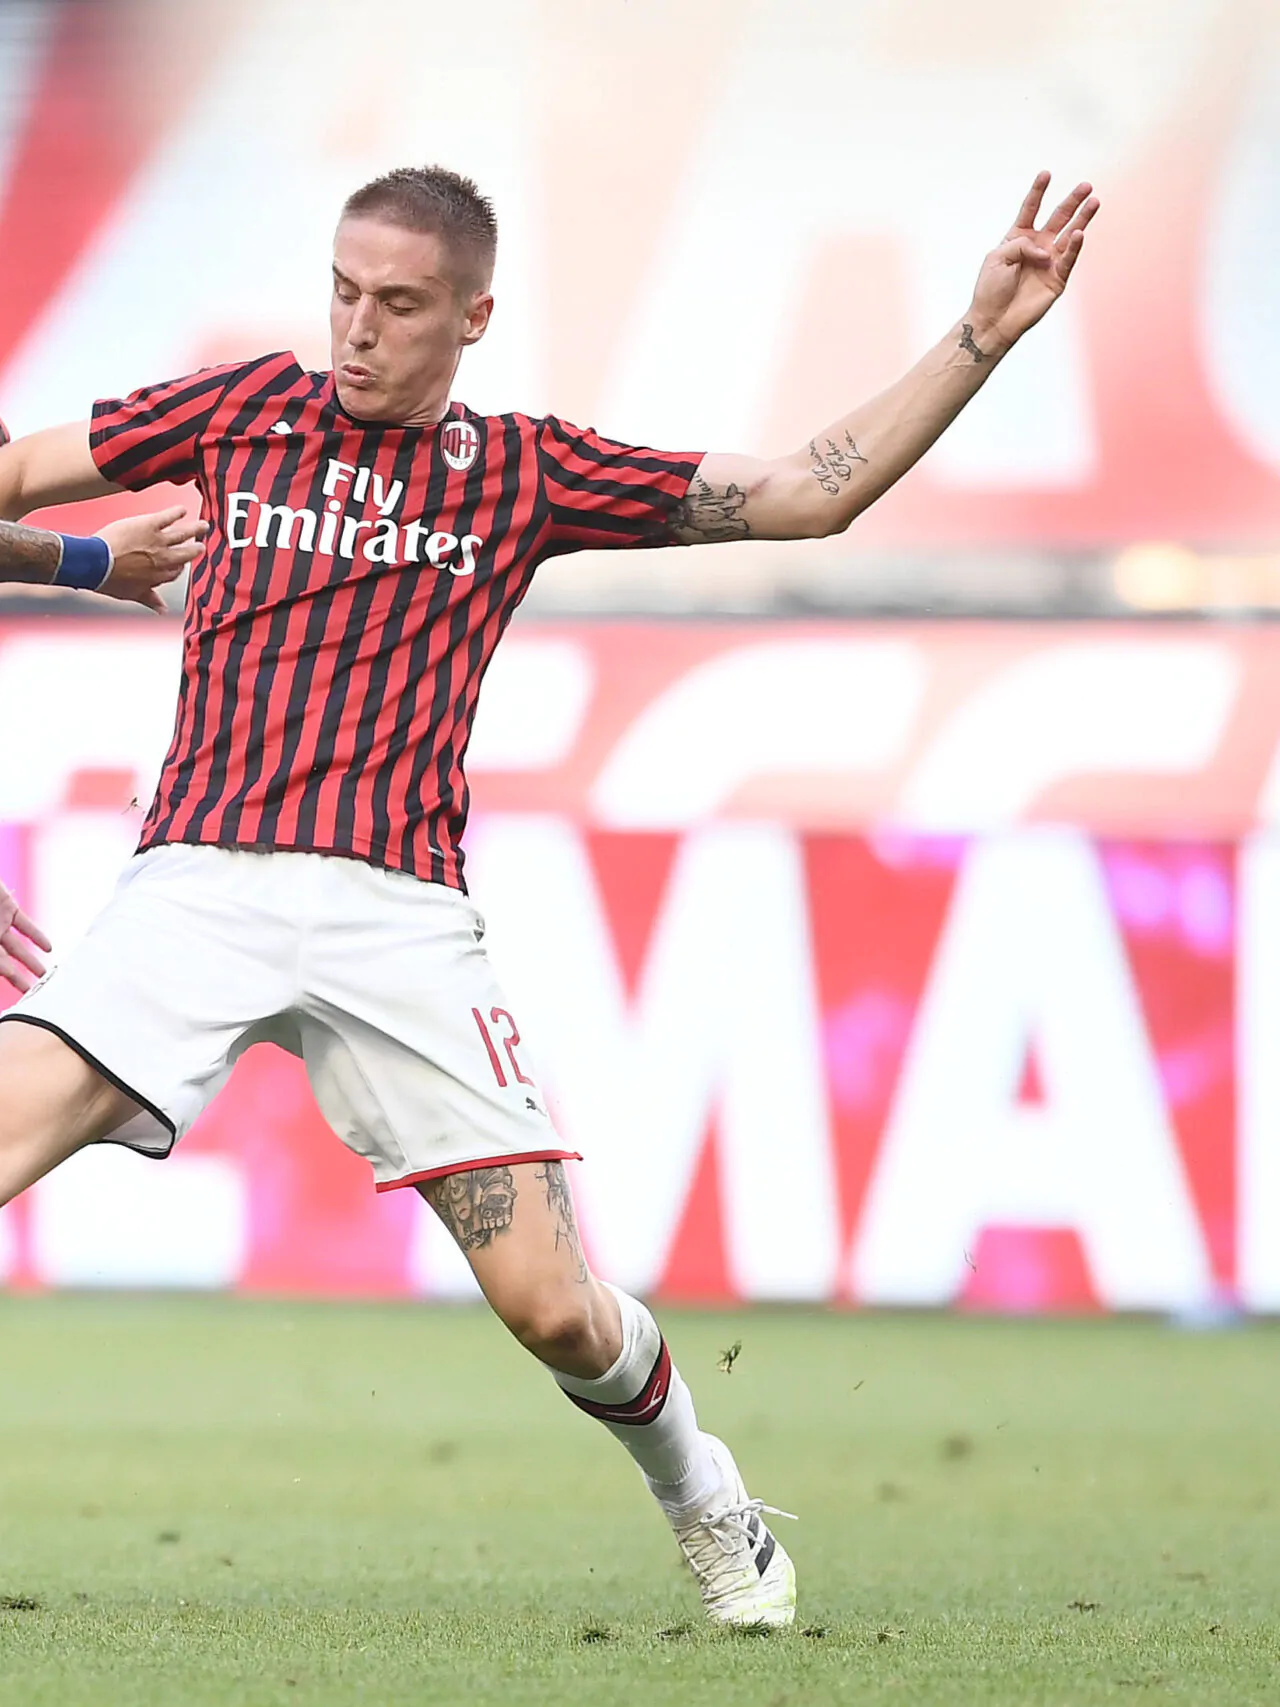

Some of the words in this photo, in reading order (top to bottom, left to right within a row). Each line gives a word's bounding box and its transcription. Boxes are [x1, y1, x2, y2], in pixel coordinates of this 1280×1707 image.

[322, 458, 403, 516] Fly
[227, 492, 483, 576] Emirates
[471, 1006, 535, 1087] 12
